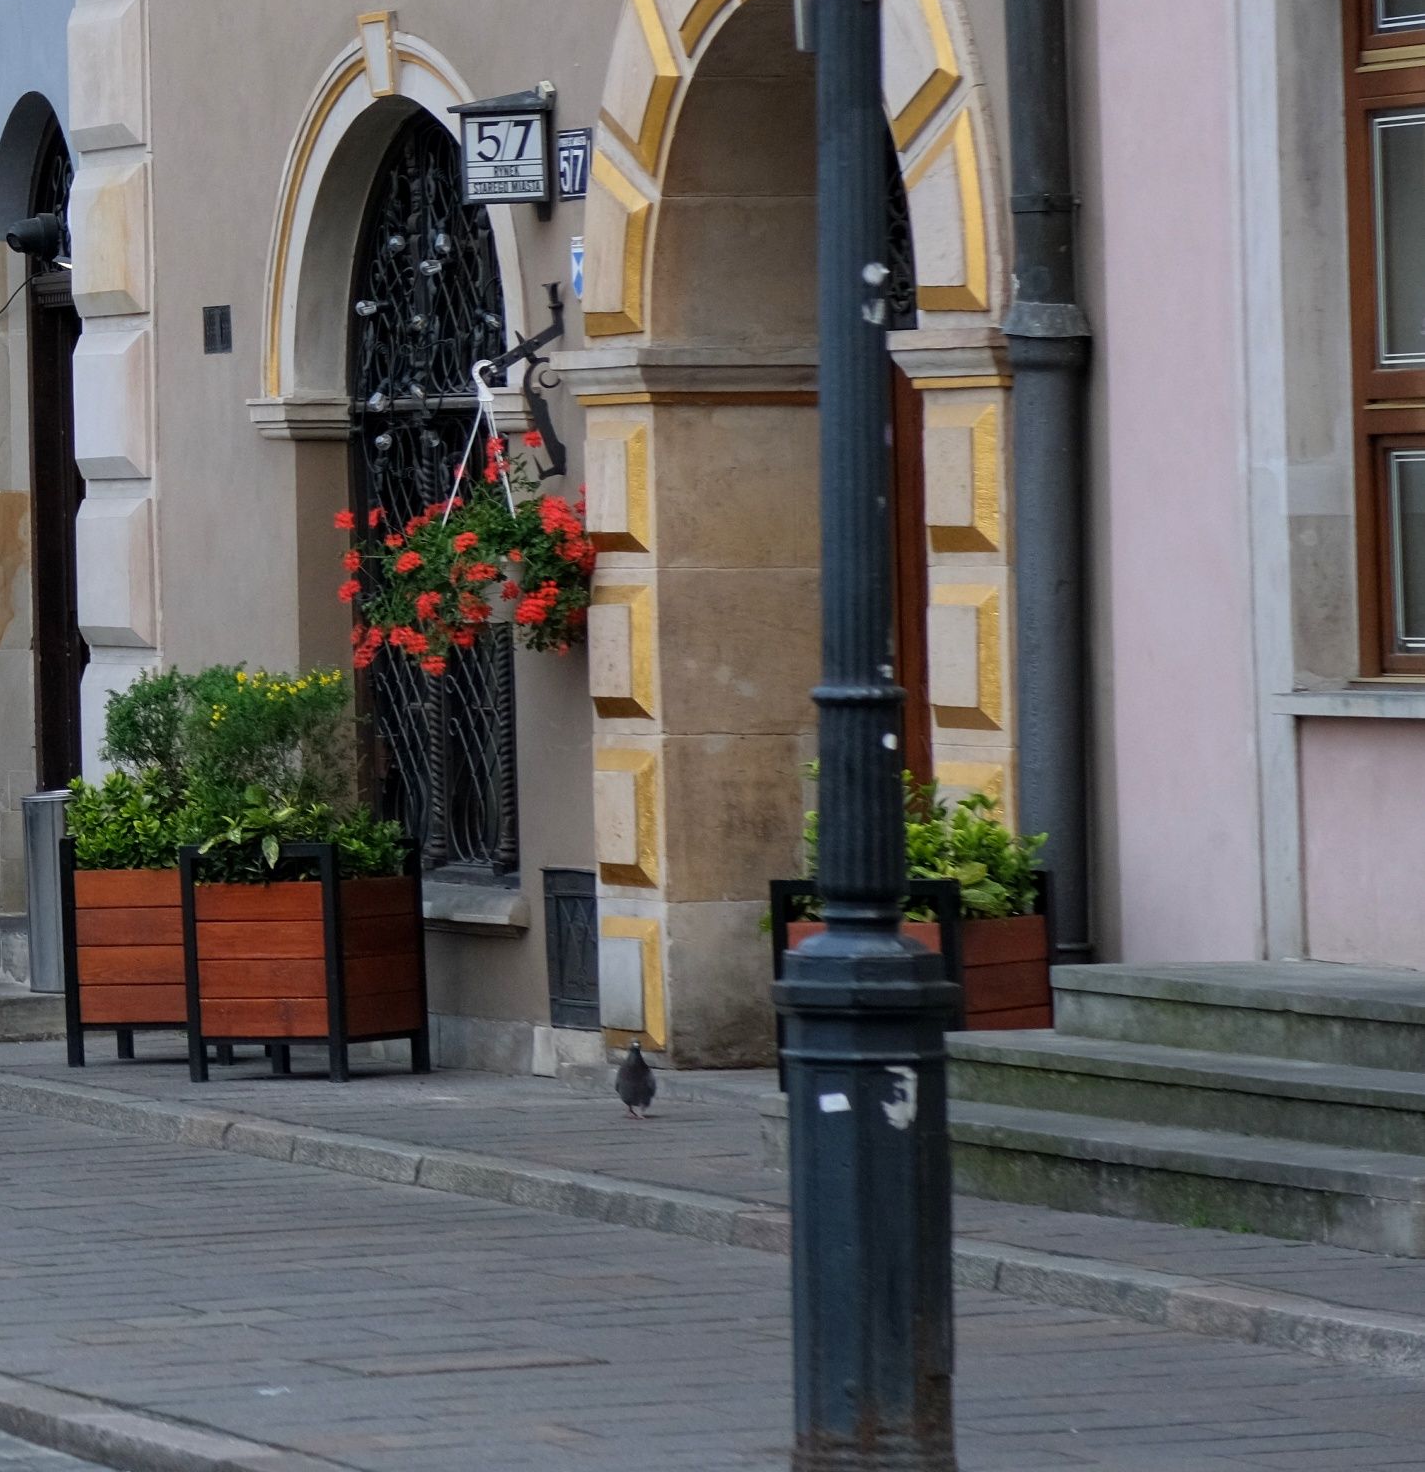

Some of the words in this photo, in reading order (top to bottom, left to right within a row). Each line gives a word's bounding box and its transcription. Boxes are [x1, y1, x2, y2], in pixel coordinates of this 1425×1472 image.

[477, 120, 533, 161] 5/7
[493, 165, 519, 177] RYNEK
[559, 149, 585, 193] 5/7
[473, 181, 508, 194] STAREGO
[511, 180, 541, 192] MIASTA
